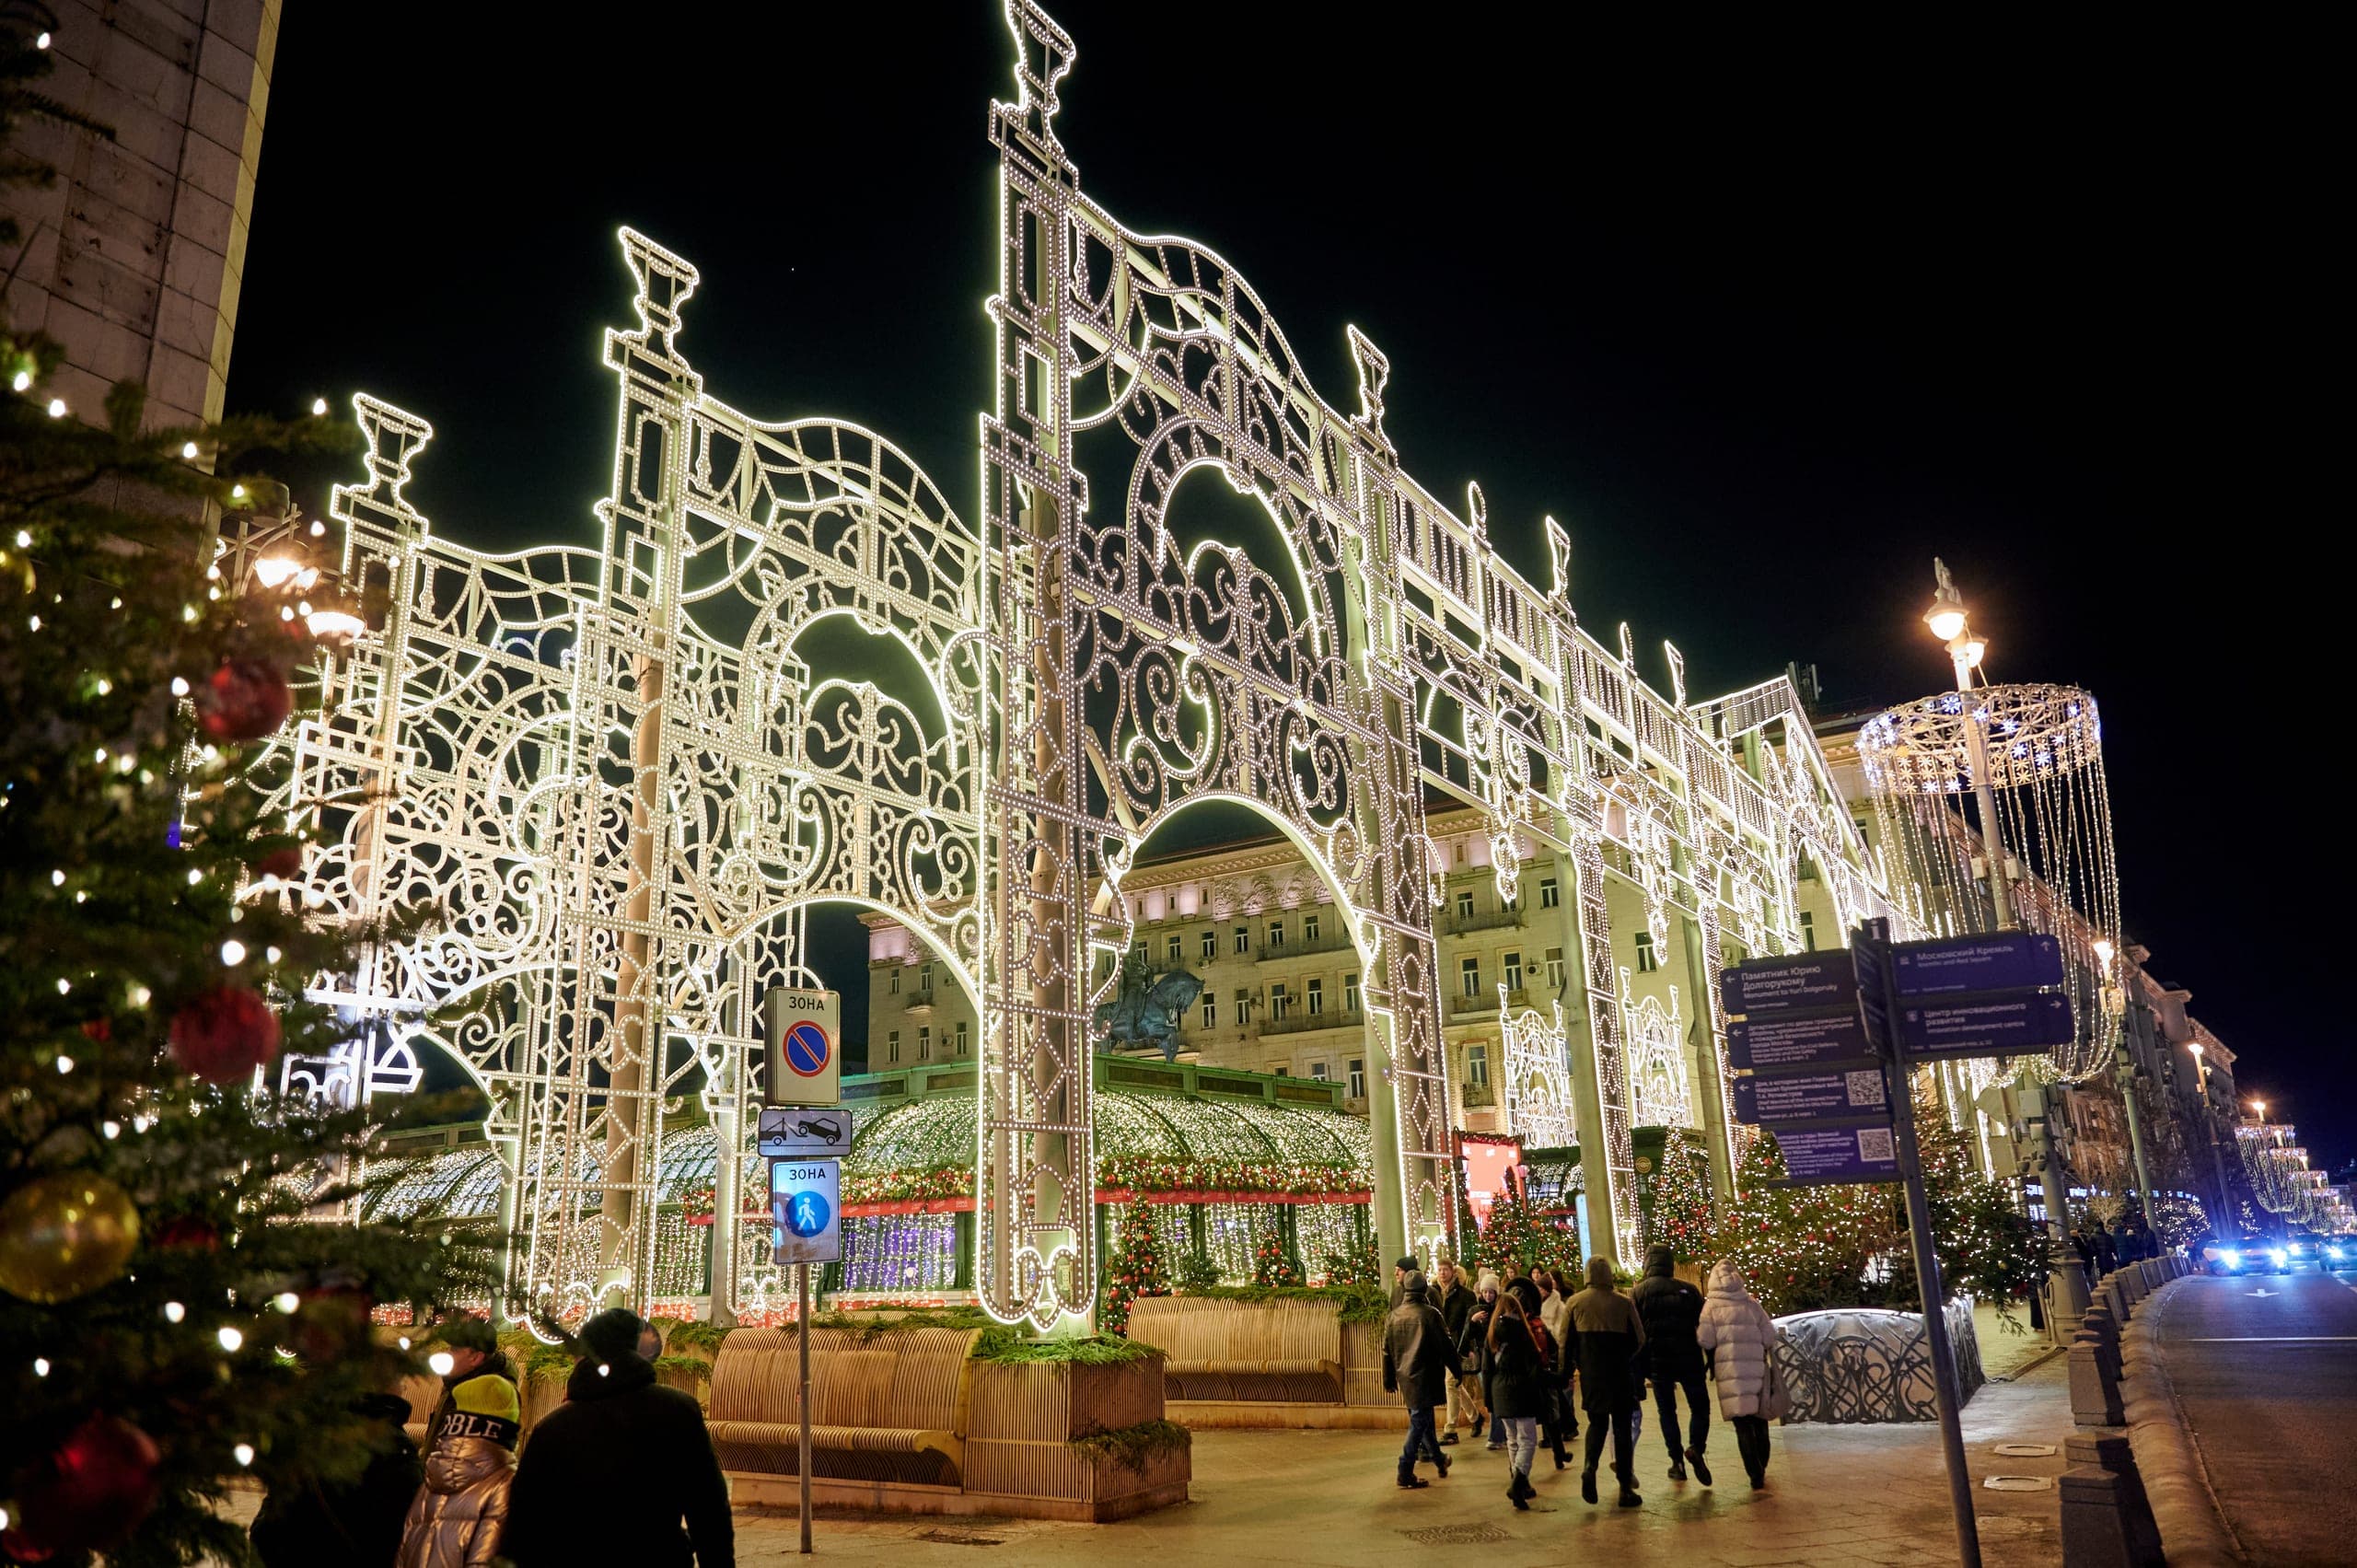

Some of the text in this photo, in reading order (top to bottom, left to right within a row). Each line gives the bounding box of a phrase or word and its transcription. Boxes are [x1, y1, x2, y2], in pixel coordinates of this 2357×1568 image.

[1742, 967, 1821, 981] Памятник Юрию
[1743, 979, 1805, 992] Долгорукому
[788, 996, 825, 1011] ЗОНА
[1925, 1011, 1951, 1019] Центр
[789, 1168, 826, 1180] ЗОНА
